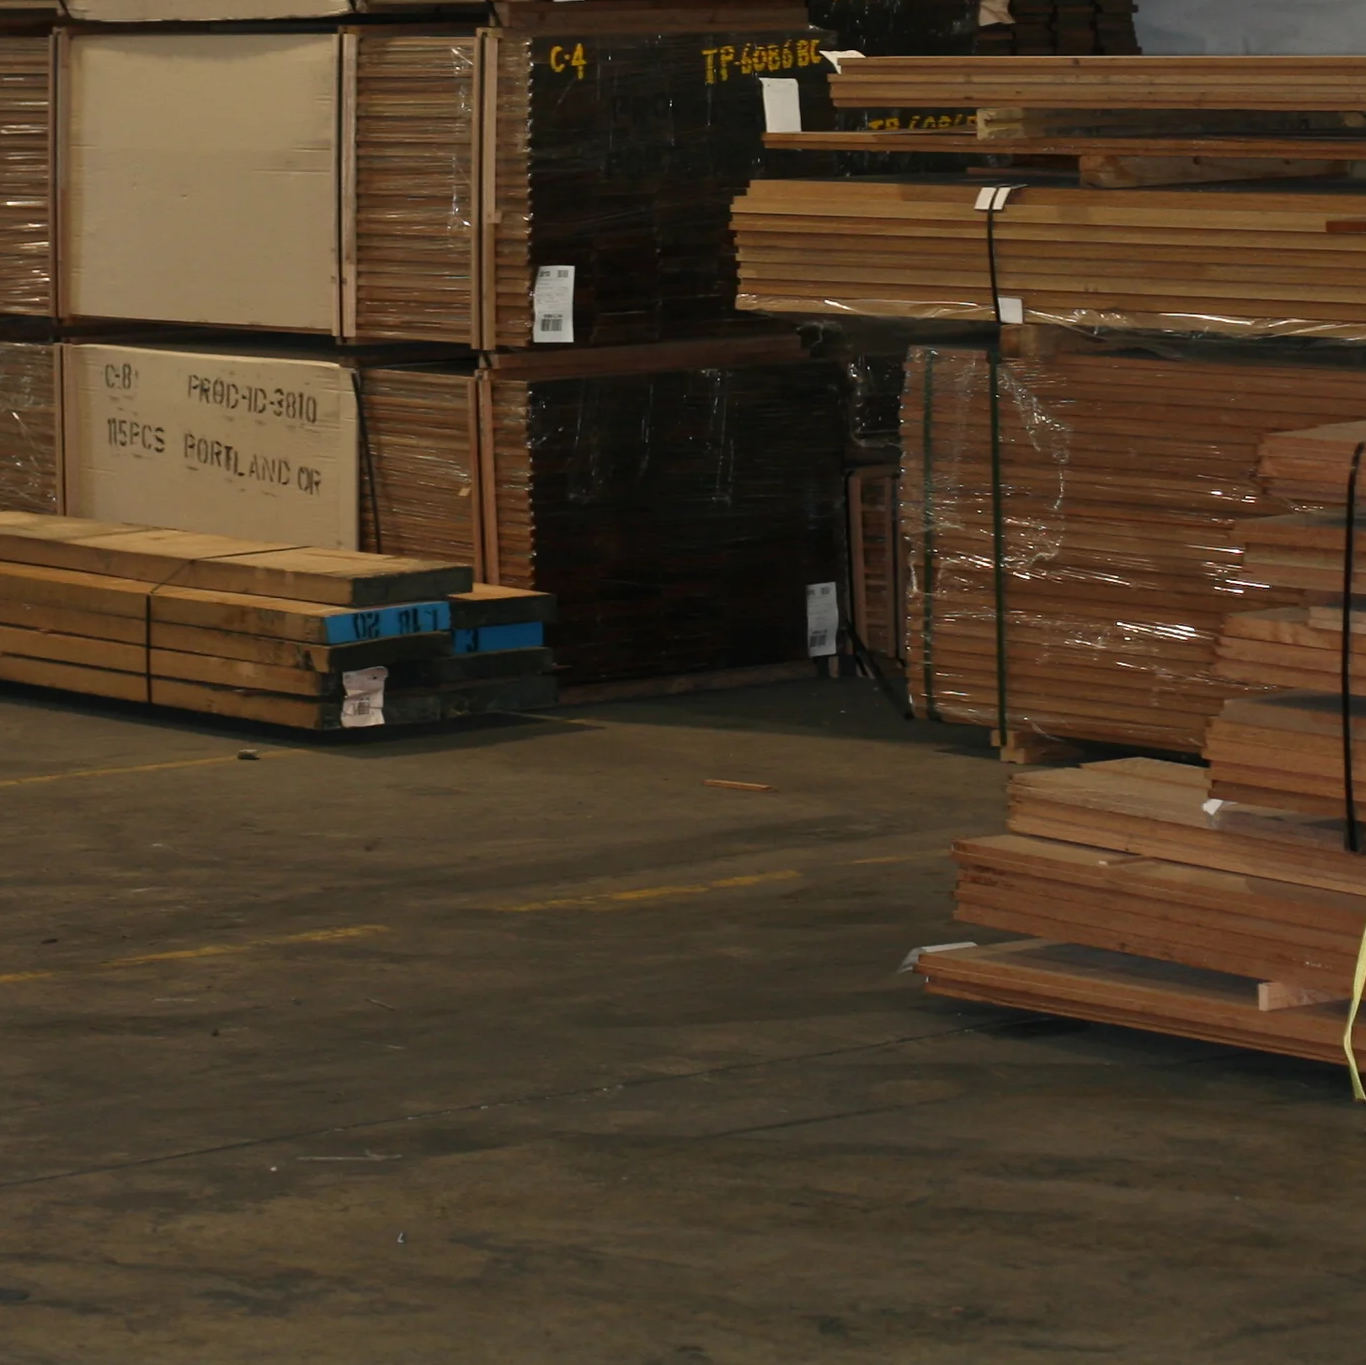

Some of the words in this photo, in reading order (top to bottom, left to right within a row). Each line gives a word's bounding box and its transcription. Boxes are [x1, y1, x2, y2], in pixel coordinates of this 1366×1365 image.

[187, 375, 318, 424] PROD-ID-3810
[184, 433, 292, 486] PORTLAND
[297, 466, 323, 495] OR
